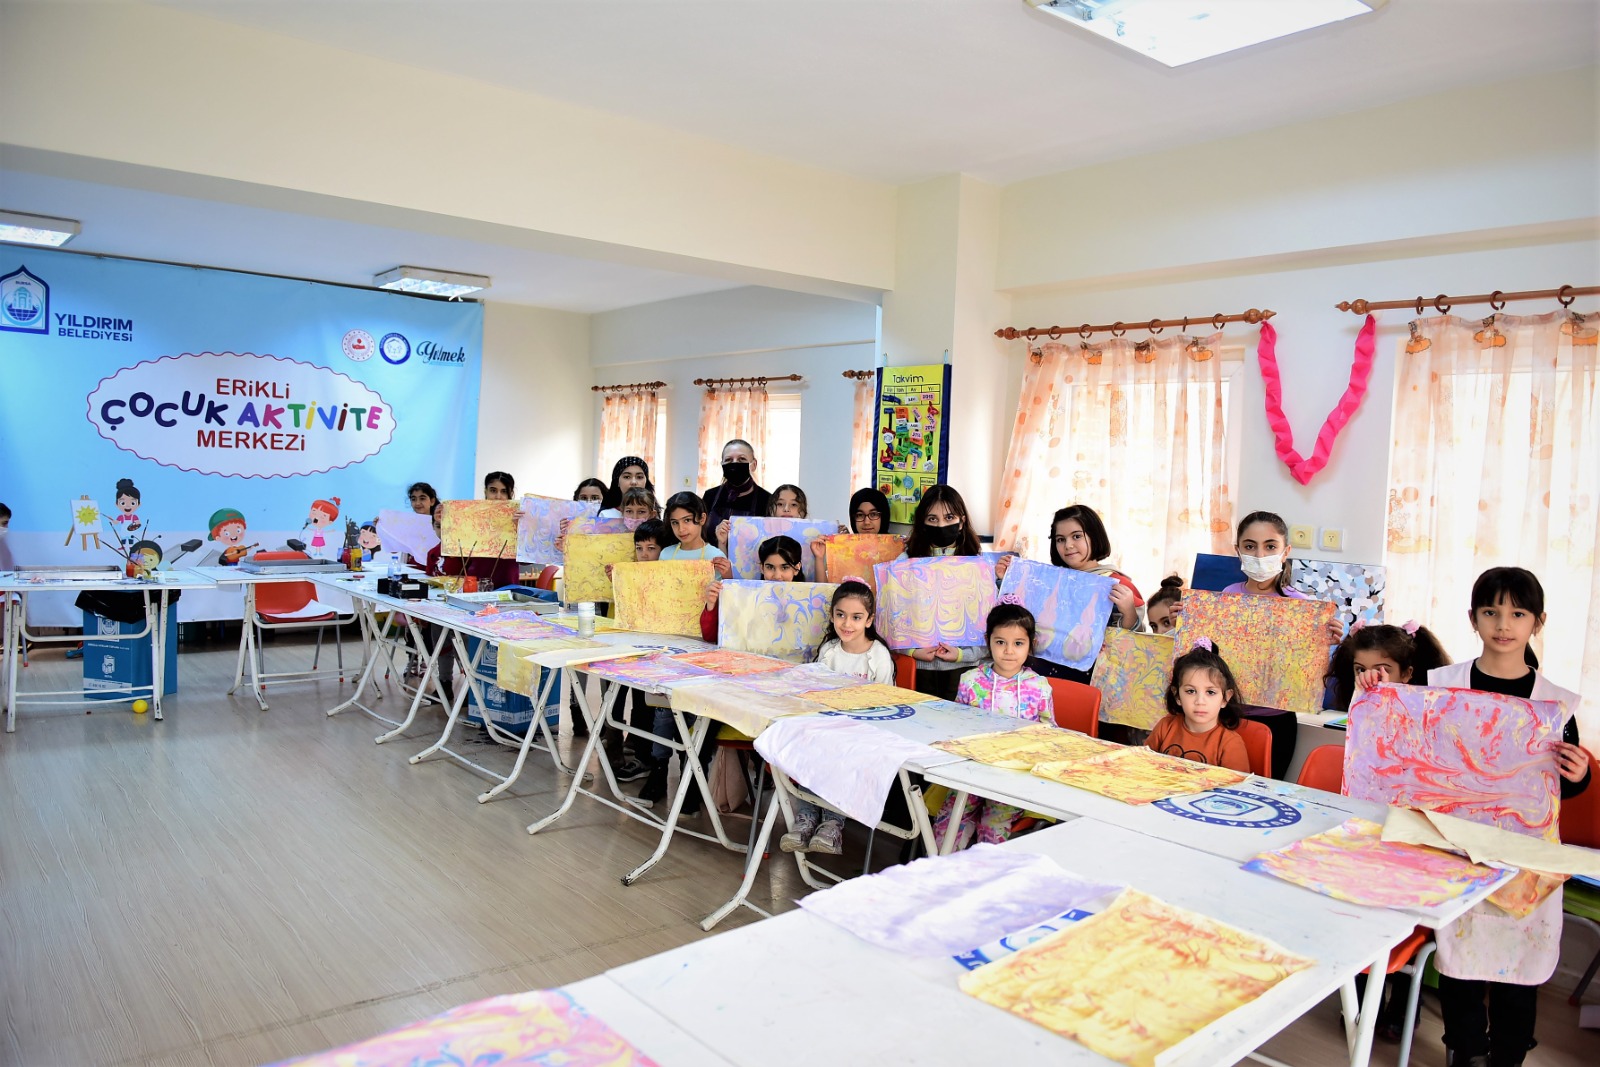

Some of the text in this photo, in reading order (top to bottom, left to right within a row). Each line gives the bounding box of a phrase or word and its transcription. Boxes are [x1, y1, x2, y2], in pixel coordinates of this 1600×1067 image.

[54, 313, 133, 332] YILDIRIM
[893, 375, 924, 384] Takvim
[100, 390, 229, 431] ÇOCUK
